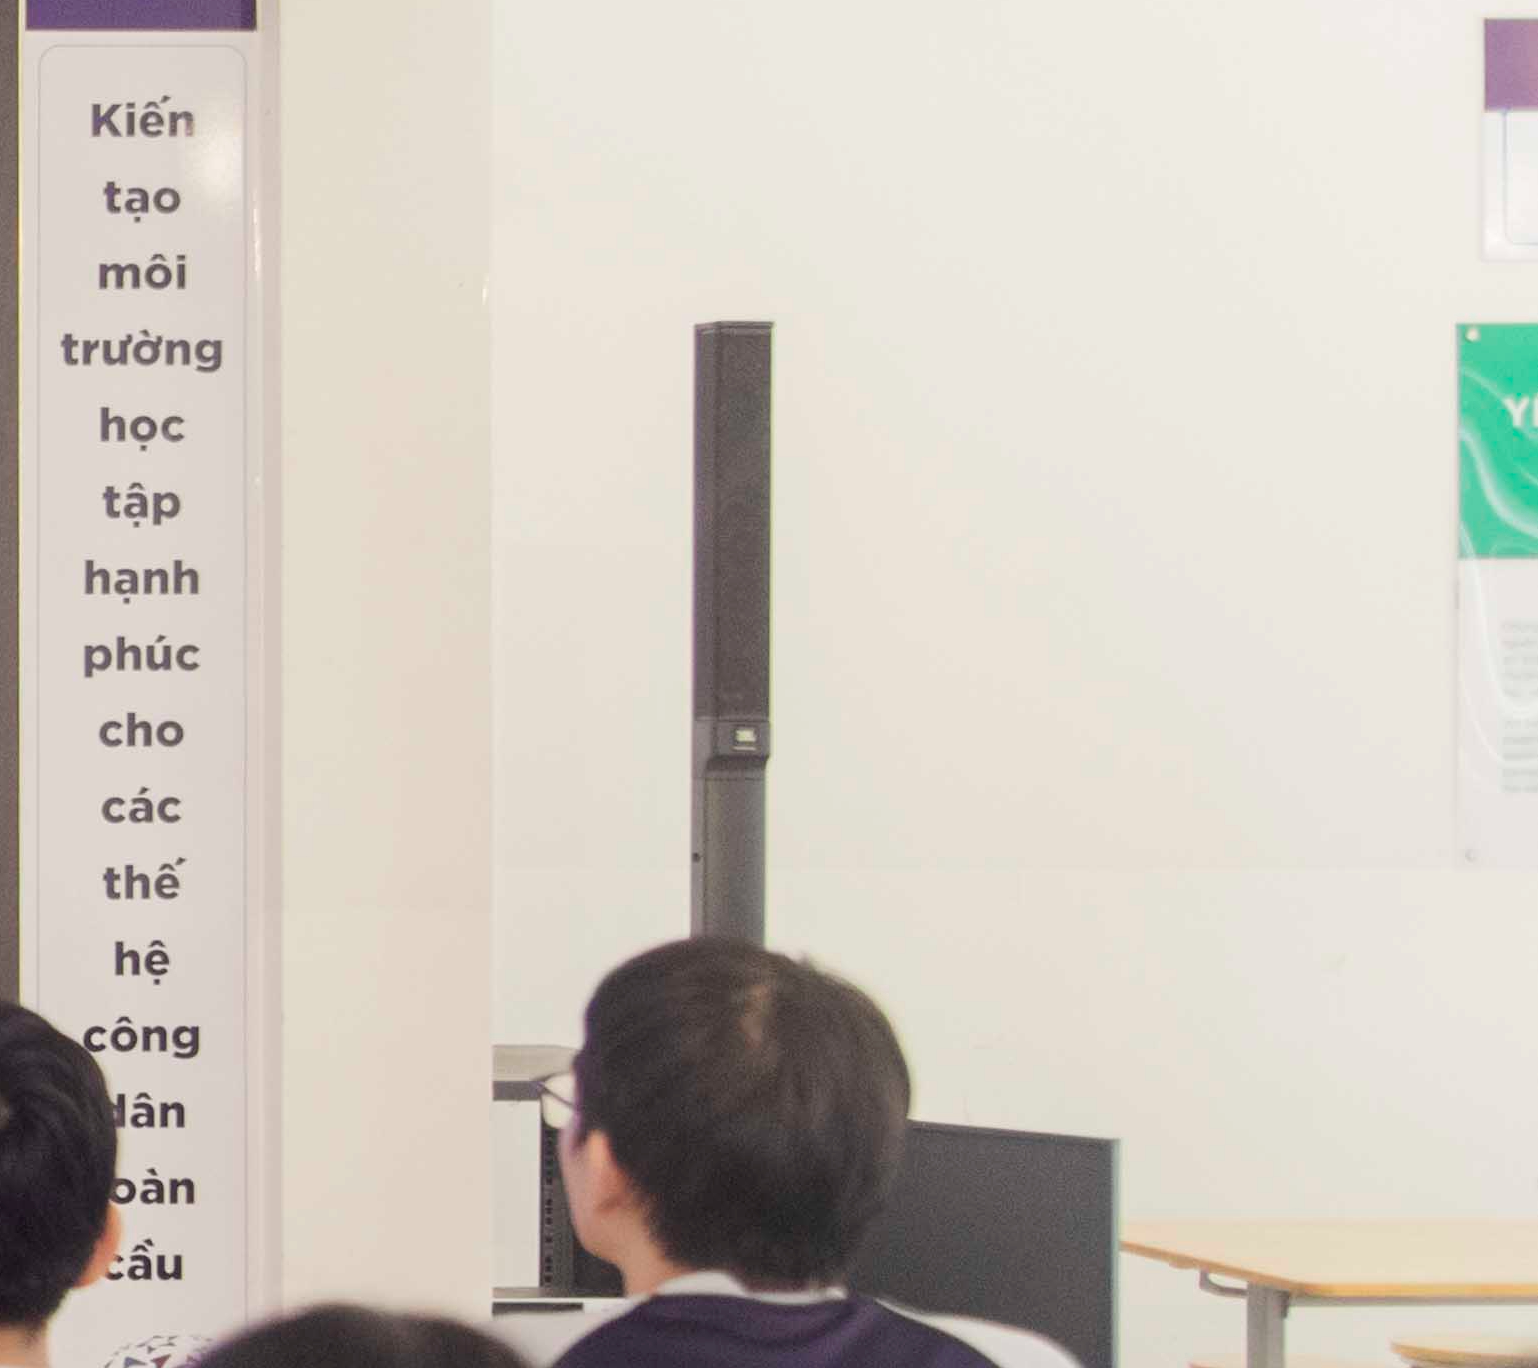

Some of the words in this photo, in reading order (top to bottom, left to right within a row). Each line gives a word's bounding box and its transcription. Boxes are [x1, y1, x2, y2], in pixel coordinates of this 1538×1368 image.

[90, 96, 194, 139] Kiến
[104, 181, 181, 220] tạo
[98, 255, 187, 290] môi
[61, 329, 223, 373] trường
[99, 407, 186, 451] học
[103, 481, 181, 528] tập
[84, 560, 199, 605] hạnh
[84, 635, 200, 678] phúc
[98, 711, 185, 748] cho
[101, 786, 182, 824] các
[103, 857, 187, 900] thế
[114, 941, 171, 985] hệ
[83, 1016, 200, 1059] công
[105, 1238, 184, 1281] cầu
